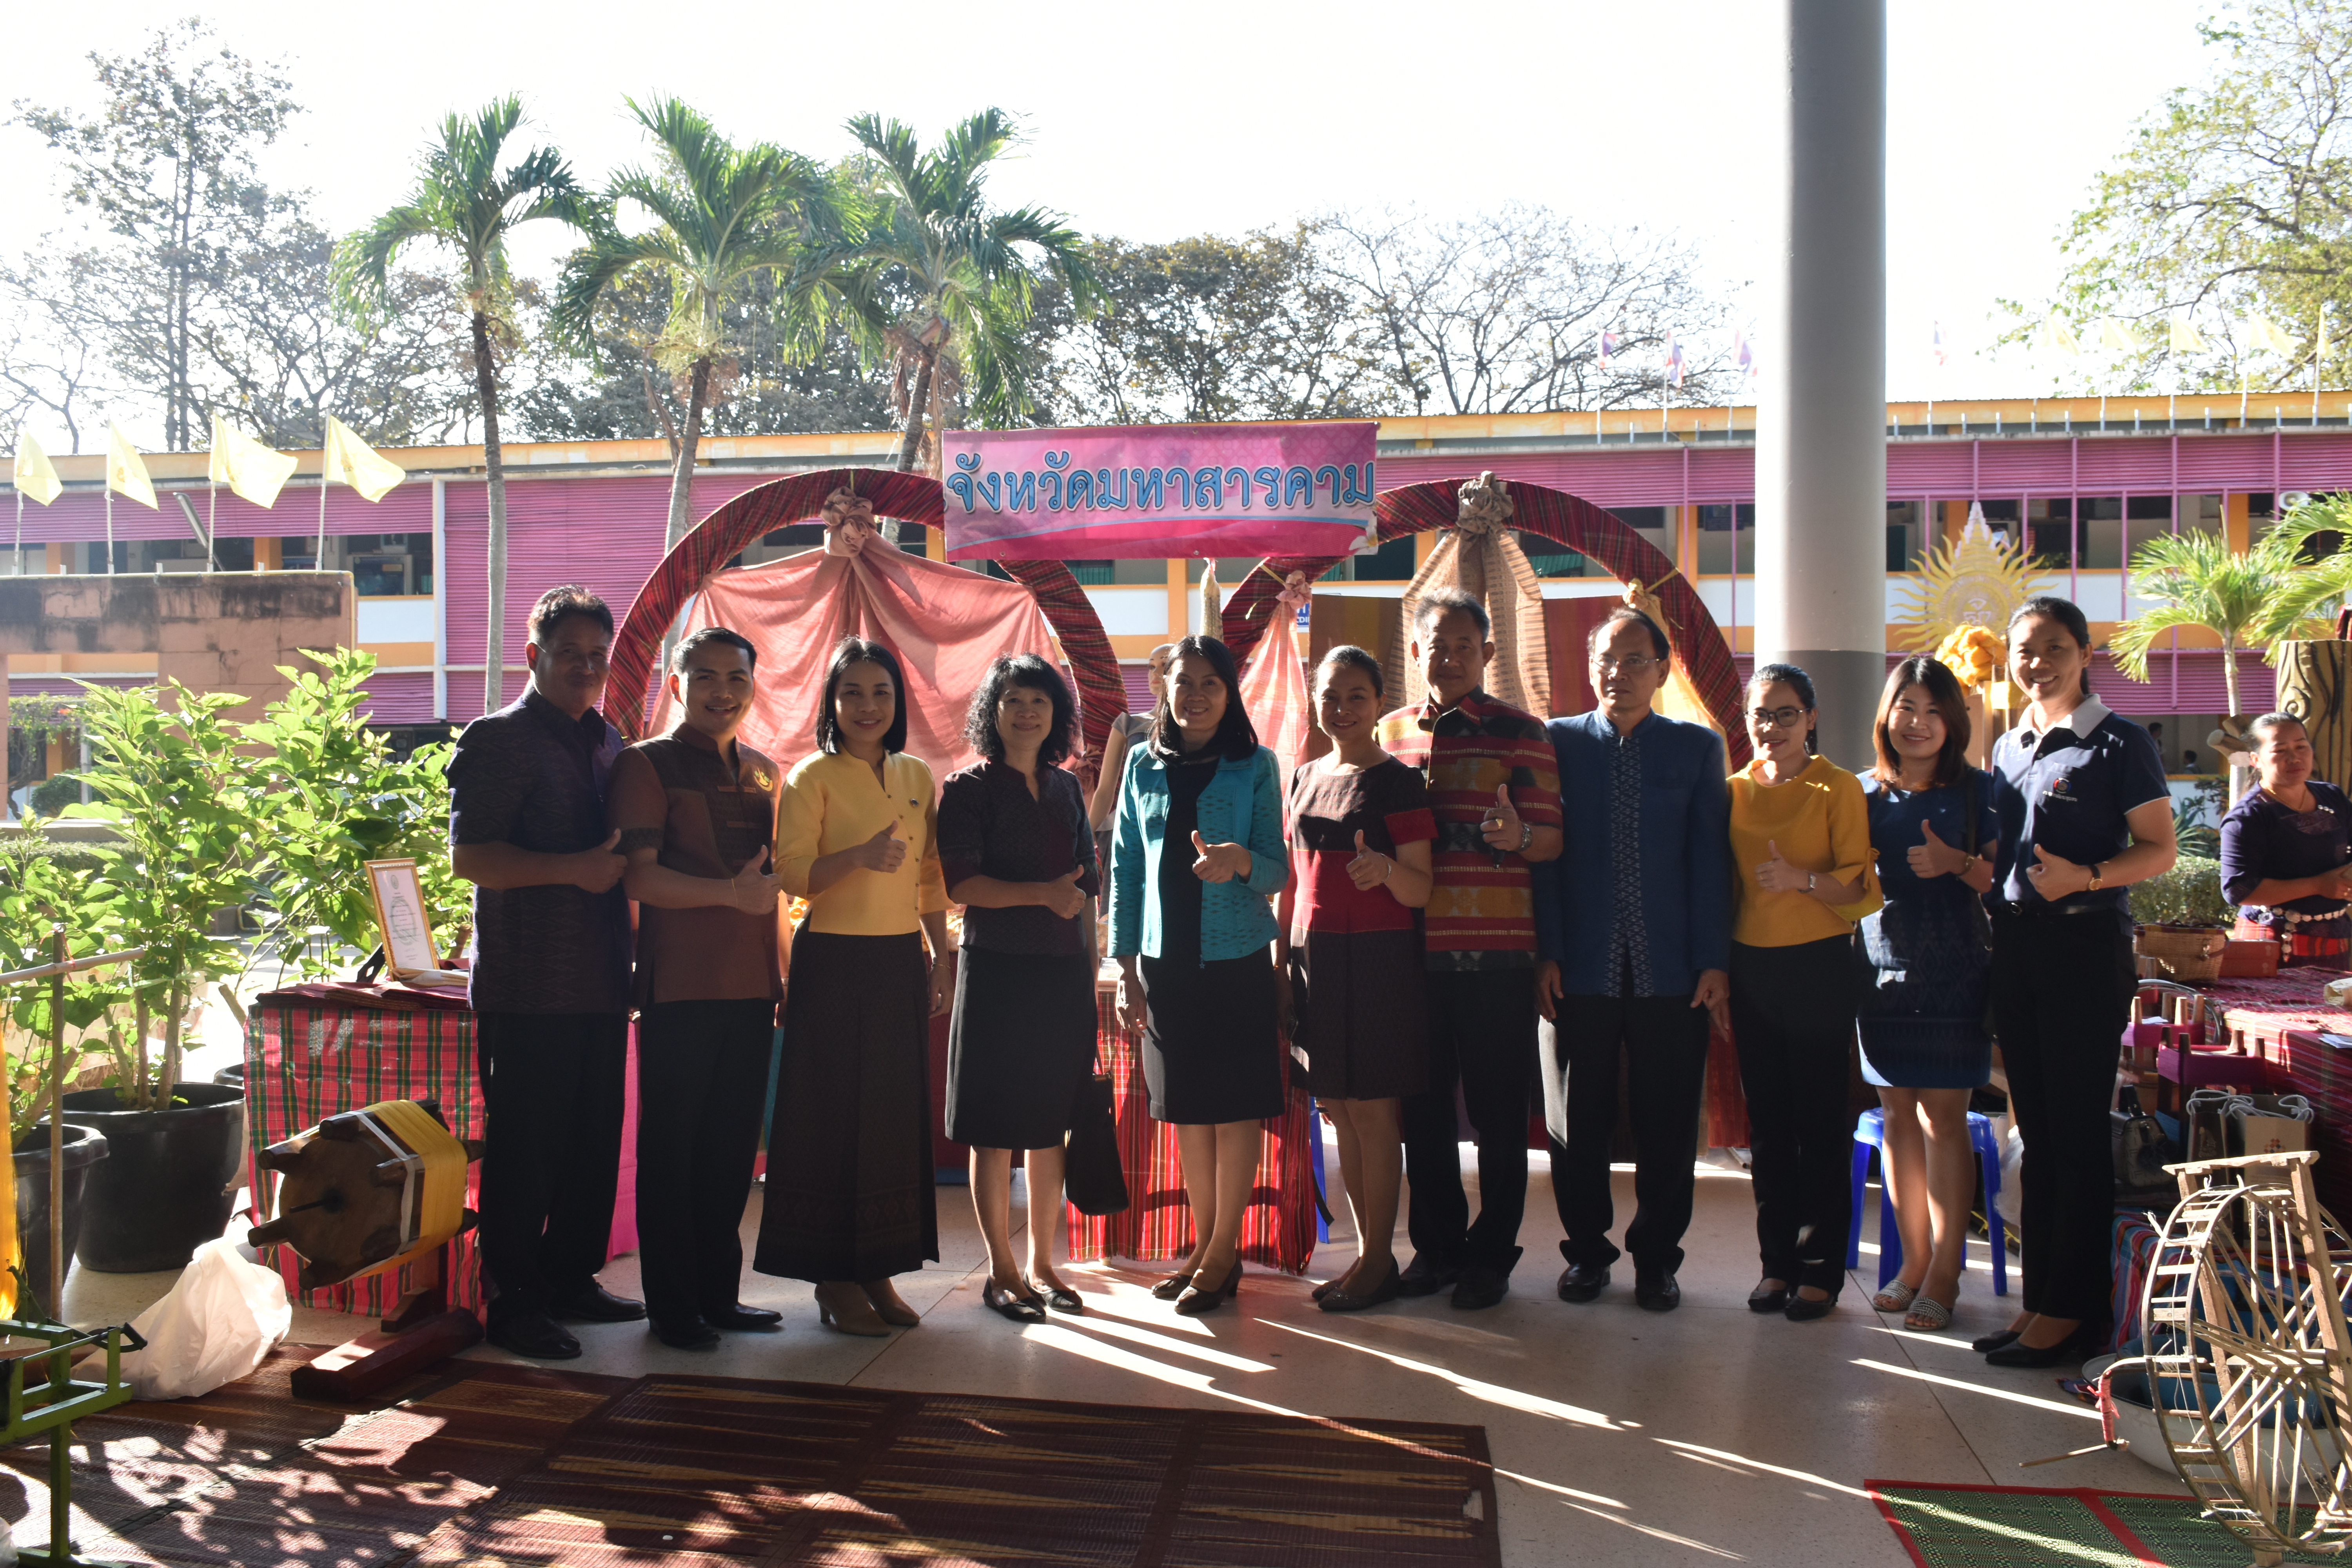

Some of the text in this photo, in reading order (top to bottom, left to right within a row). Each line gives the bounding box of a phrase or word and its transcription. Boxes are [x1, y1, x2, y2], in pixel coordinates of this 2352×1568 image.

[946, 451, 1374, 512] จังหวัดมหาสารคาม
